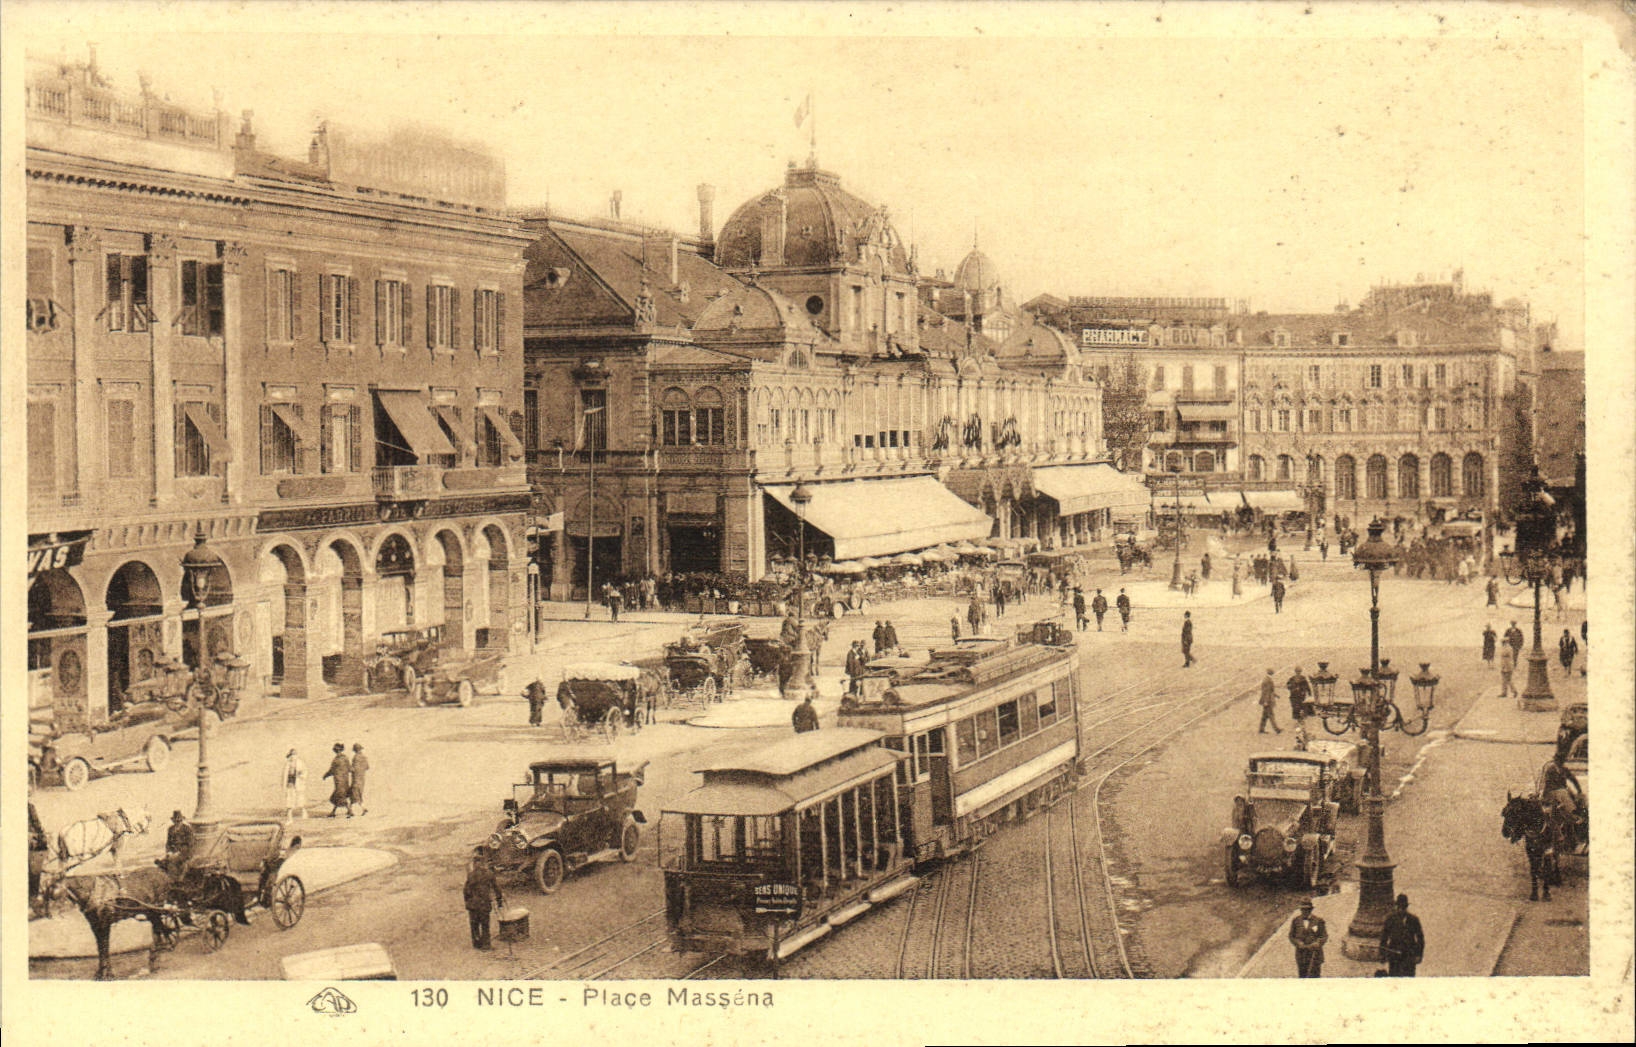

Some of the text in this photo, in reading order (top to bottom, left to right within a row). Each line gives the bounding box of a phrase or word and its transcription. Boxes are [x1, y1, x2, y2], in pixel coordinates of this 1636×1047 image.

[1082, 328, 1148, 344] PHARMACY
[754, 884, 798, 896] SENS UNIQUE
